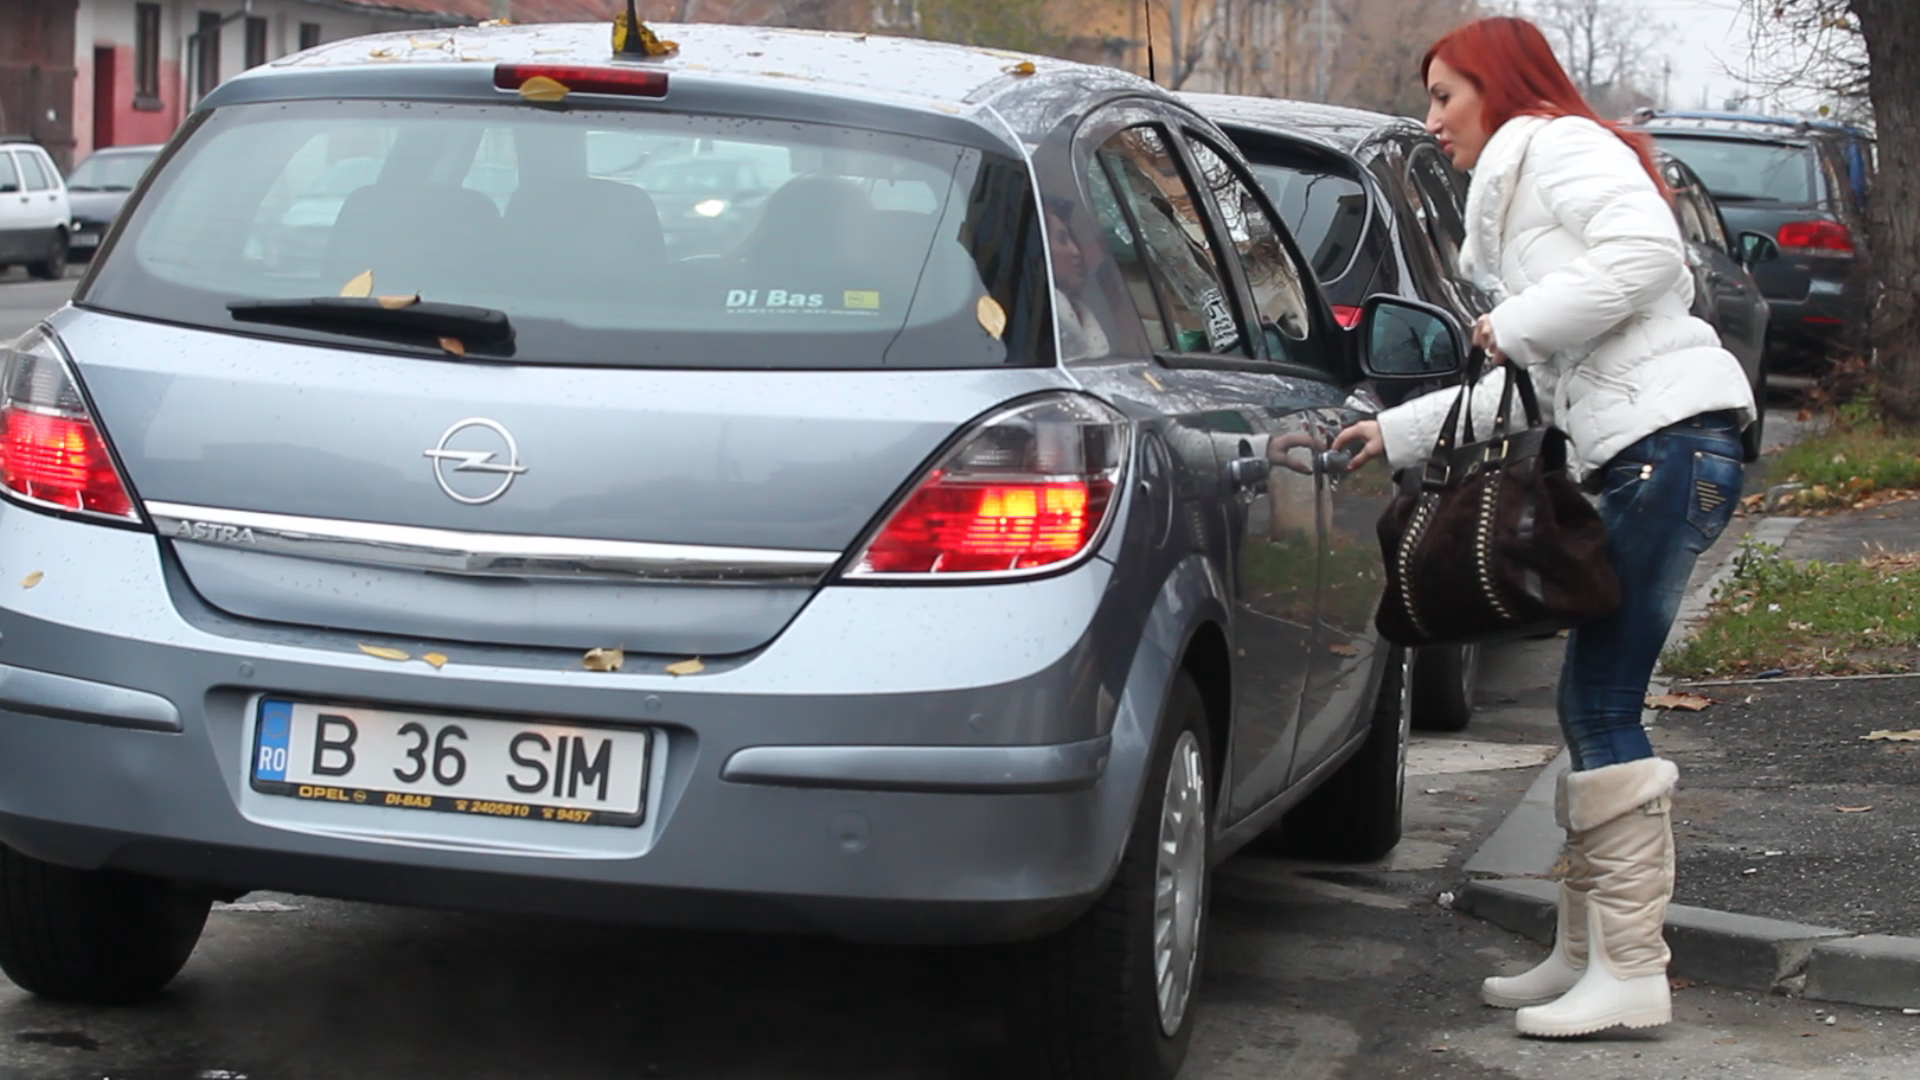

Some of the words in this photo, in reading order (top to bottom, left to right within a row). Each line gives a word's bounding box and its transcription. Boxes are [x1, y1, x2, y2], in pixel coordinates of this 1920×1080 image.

[726, 289, 758, 307] Di
[766, 289, 824, 307] Bas
[177, 520, 256, 544] ASTRA
[259, 745, 285, 772] RO
[312, 713, 358, 776] B
[393, 722, 468, 786] 36
[506, 731, 613, 801] SIM
[299, 785, 349, 801] OPEL
[385, 793, 433, 808] DI-BAS
[471, 801, 529, 817] 2405810
